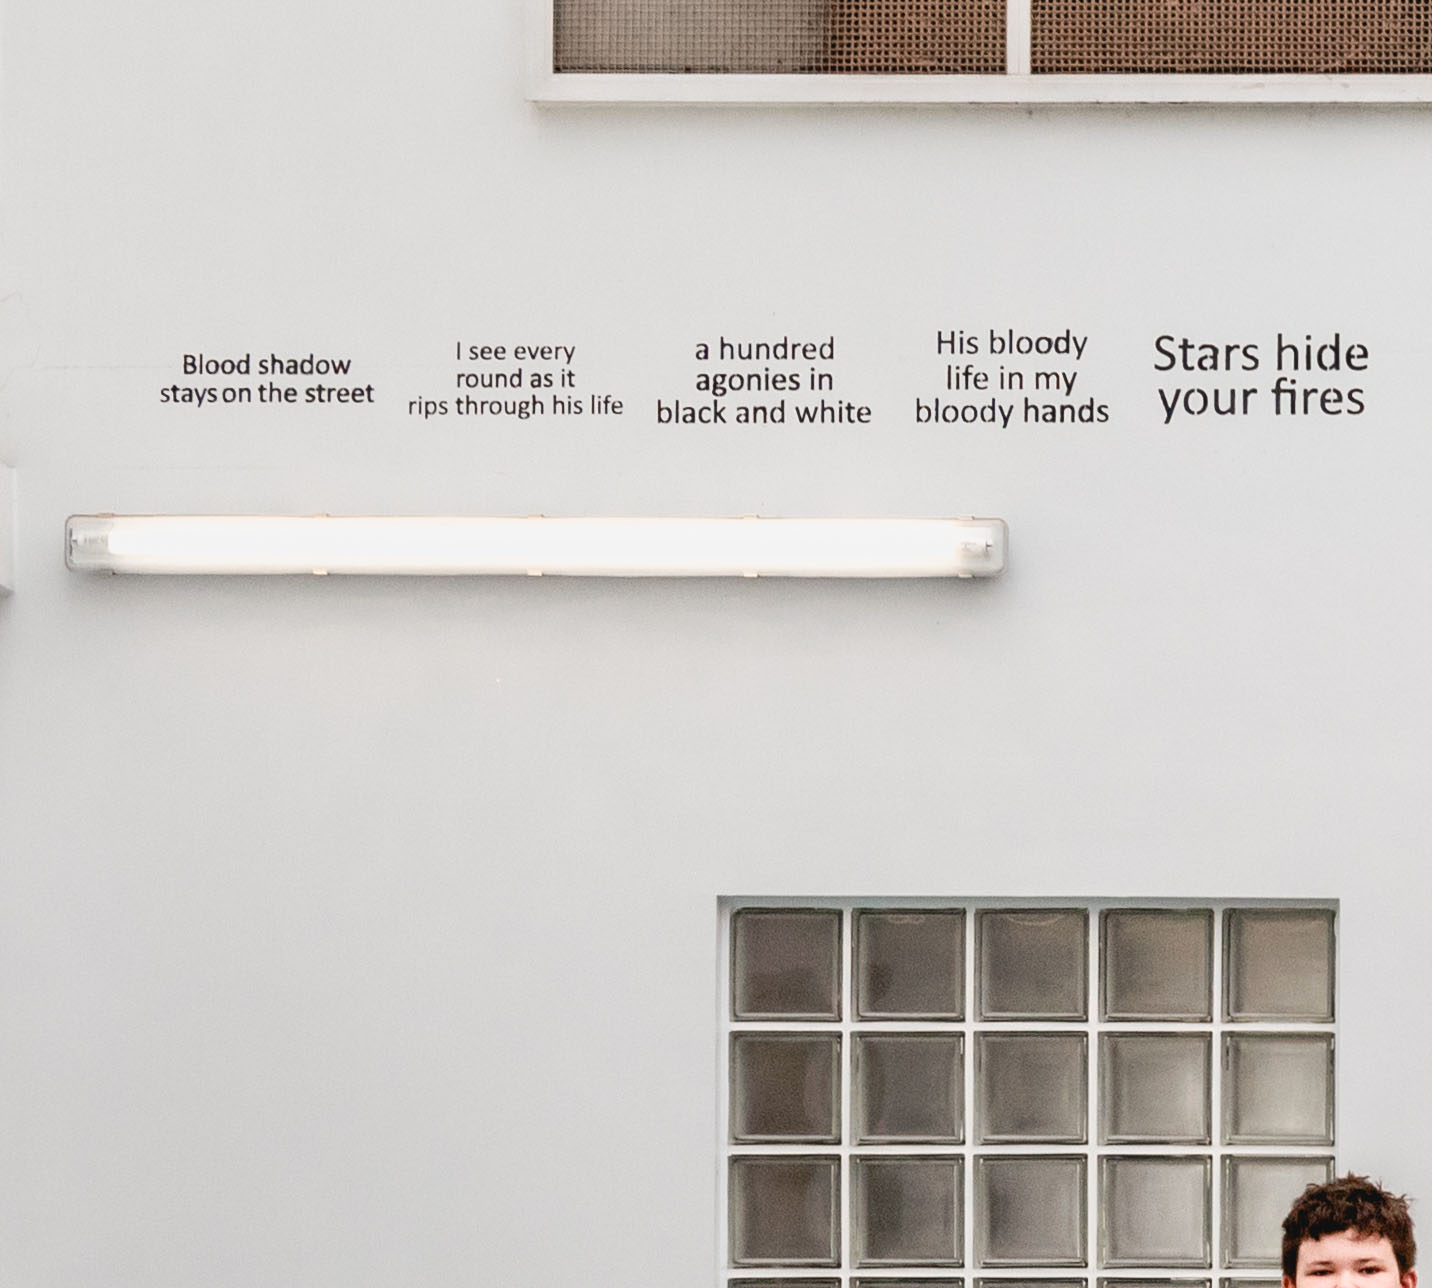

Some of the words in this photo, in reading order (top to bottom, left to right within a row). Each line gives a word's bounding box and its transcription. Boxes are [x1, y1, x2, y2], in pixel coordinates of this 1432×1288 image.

[455, 341, 462, 362] I
[468, 345, 507, 361] see
[513, 345, 576, 365] every
[695, 342, 709, 361] a
[719, 335, 835, 361] hundred
[937, 329, 979, 355] His
[989, 328, 1088, 361] bloody
[1153, 334, 1260, 372] Stars
[1276, 332, 1369, 372] hide
[183, 352, 251, 376] Blood
[258, 353, 352, 376] shadow
[456, 367, 523, 389] round
[529, 372, 554, 389] as
[561, 368, 576, 388] it
[695, 366, 801, 398] agonies
[810, 366, 833, 391] in
[946, 364, 989, 391] life
[999, 365, 1024, 391] in
[1035, 371, 1078, 397] my
[159, 384, 218, 408] stays
[221, 387, 252, 404] on
[257, 381, 298, 404] the
[304, 383, 375, 404] street
[408, 395, 449, 420] rips
[455, 393, 545, 420] through
[552, 394, 584, 415] his
[591, 394, 624, 415] life
[1157, 387, 1258, 425] your
[1270, 376, 1365, 416] fires
[657, 398, 727, 424] black
[735, 399, 785, 424] and
[794, 398, 872, 424] white
[915, 397, 1014, 429] bloody
[1023, 396, 1110, 424] hands
